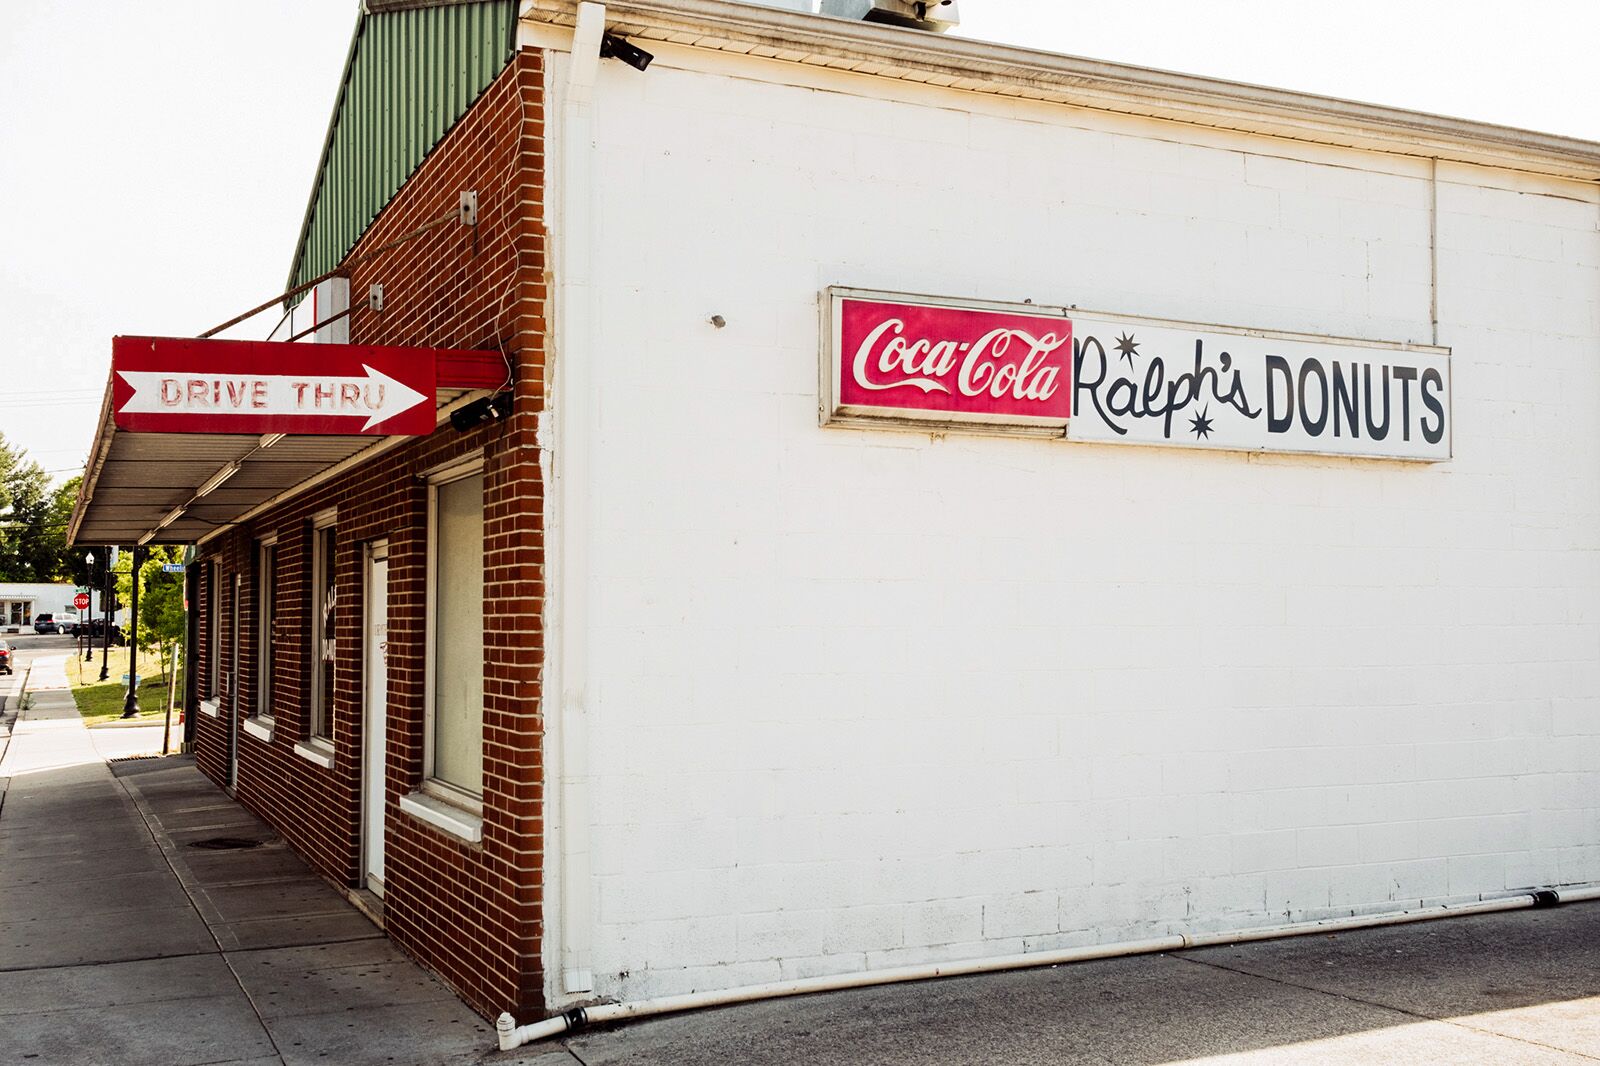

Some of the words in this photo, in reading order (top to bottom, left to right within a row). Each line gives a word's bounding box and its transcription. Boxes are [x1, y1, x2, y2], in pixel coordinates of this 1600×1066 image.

[160, 378, 268, 410] DRIVE
[291, 382, 386, 411] THRU
[852, 317, 1071, 403] Coca-Cola
[1073, 335, 1262, 440] Ralph's
[1264, 354, 1445, 445] DONUTS
